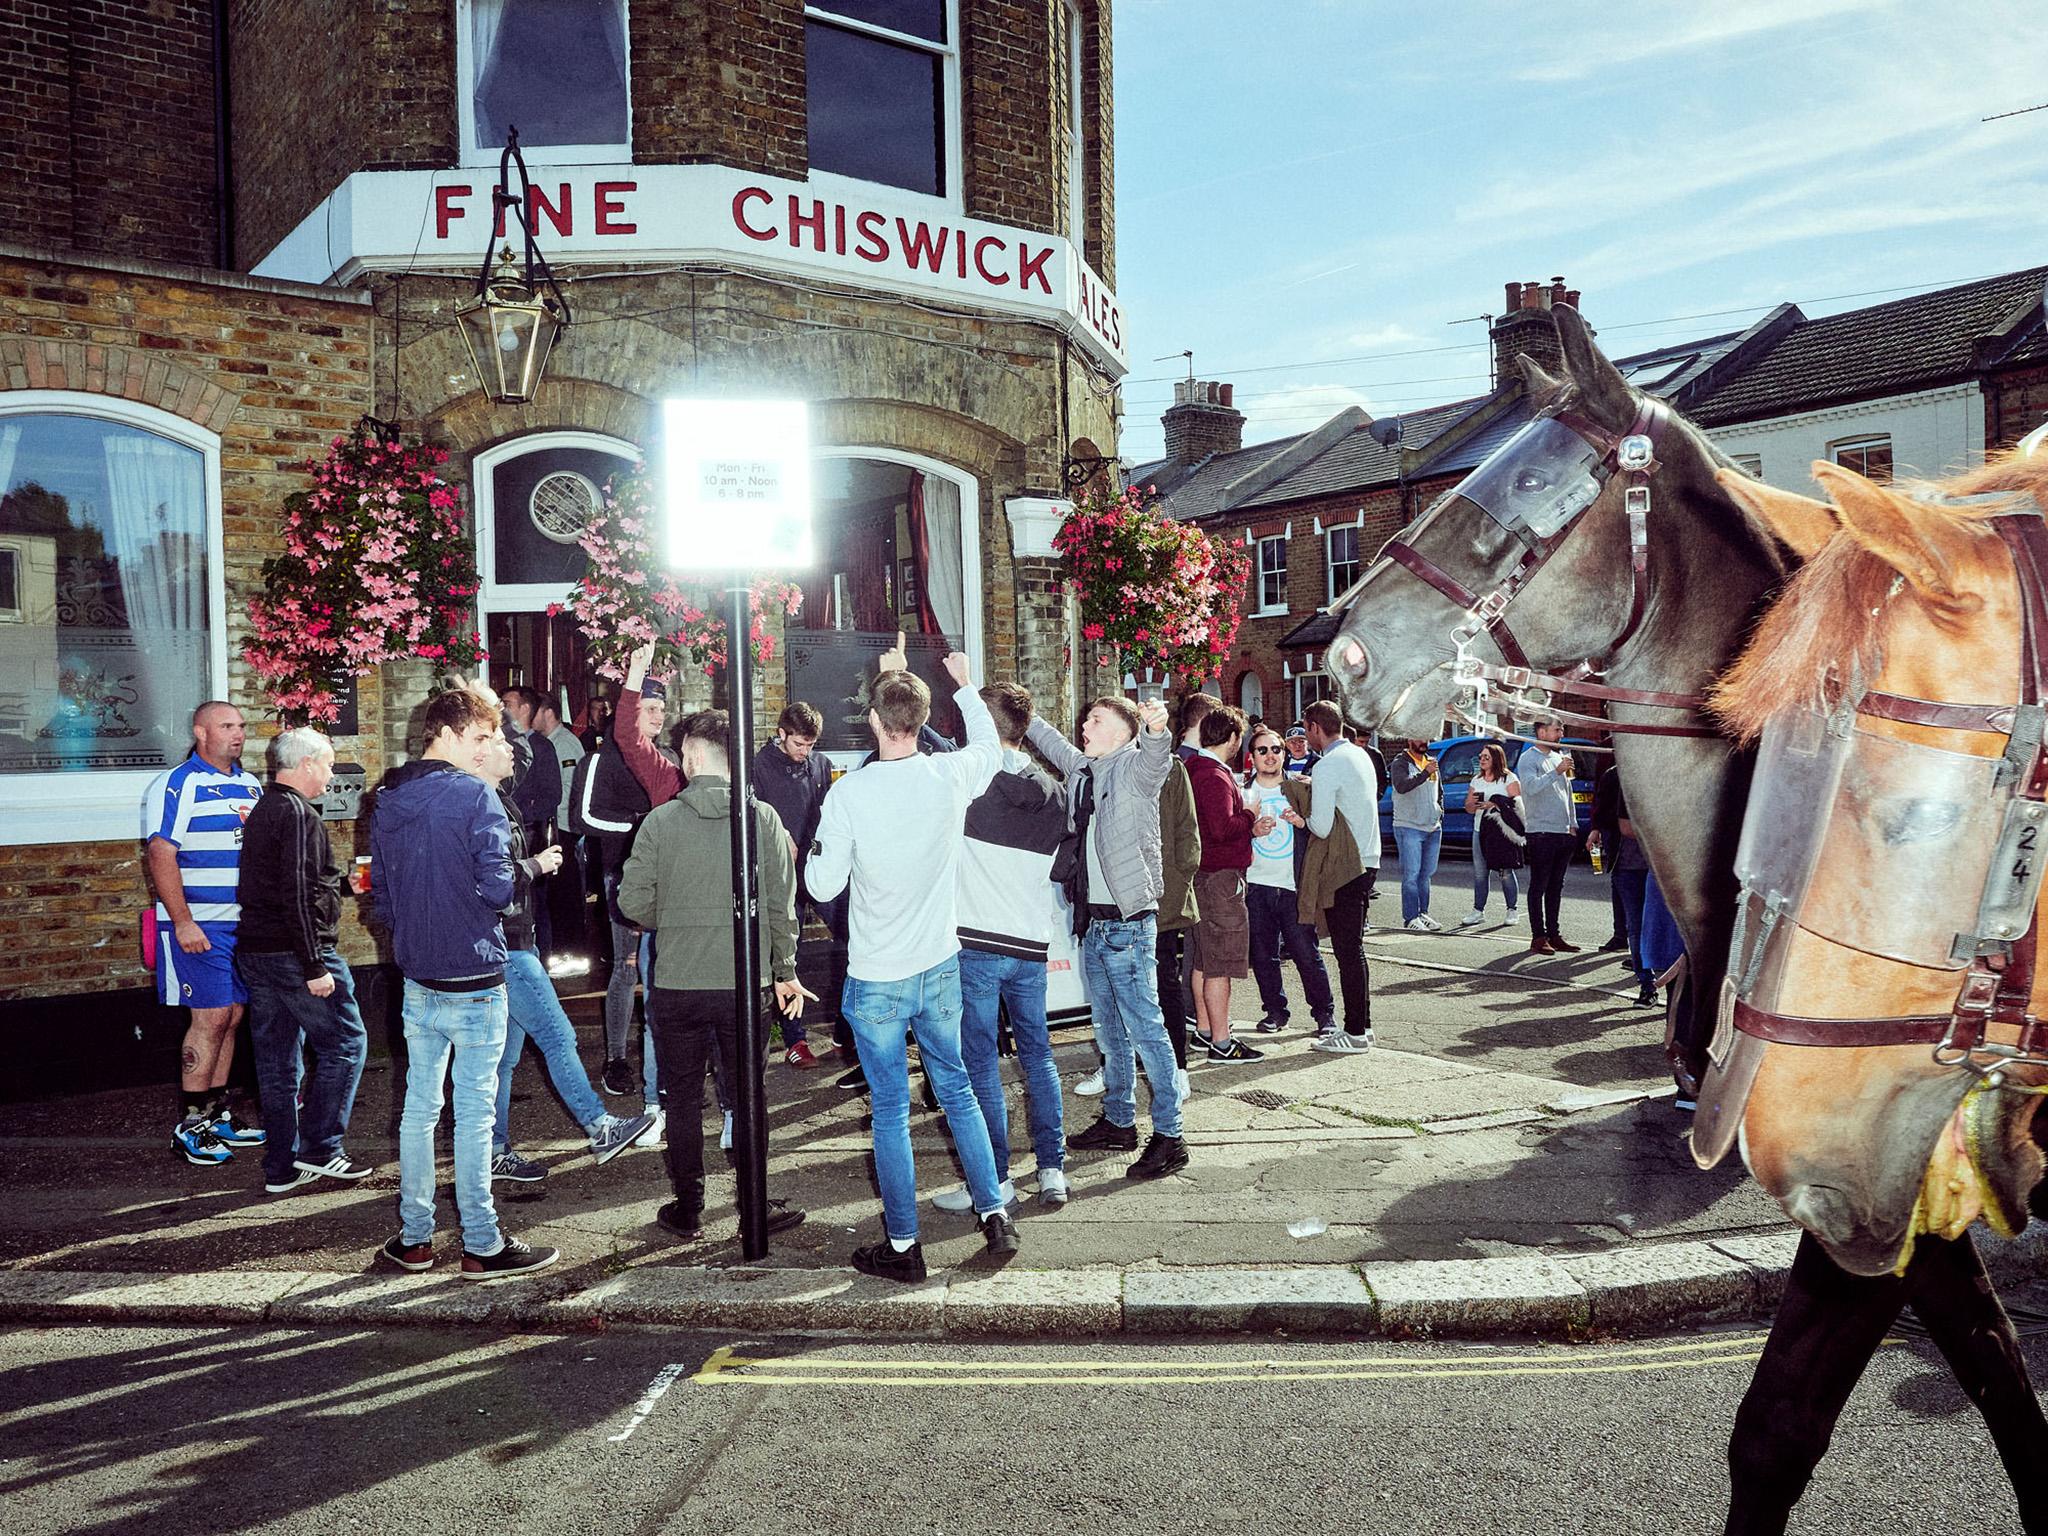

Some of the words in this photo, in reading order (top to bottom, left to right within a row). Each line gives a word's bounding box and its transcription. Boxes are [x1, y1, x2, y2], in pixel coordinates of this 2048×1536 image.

[435, 181, 638, 239] FINE
[731, 186, 1055, 295] CHISWICK
[716, 463, 740, 473] Mon
[751, 463, 766, 473] Fri
[703, 475, 718, 486] 10
[720, 477, 738, 486] am
[747, 476, 778, 486] Noon
[718, 488, 726, 498] 6
[737, 488, 744, 498] 8
